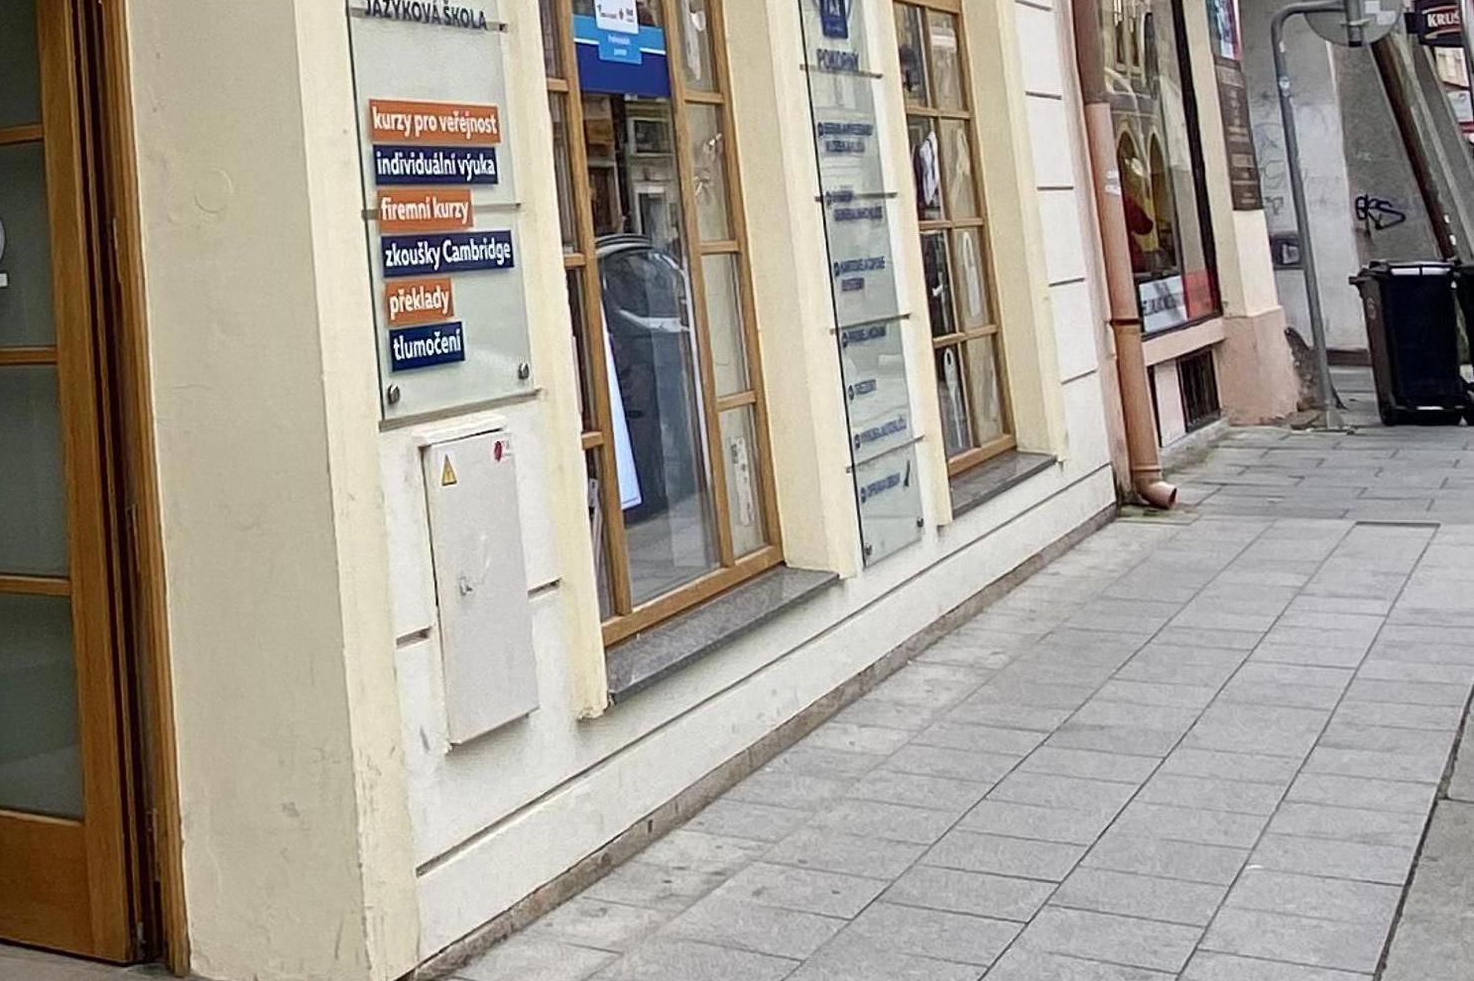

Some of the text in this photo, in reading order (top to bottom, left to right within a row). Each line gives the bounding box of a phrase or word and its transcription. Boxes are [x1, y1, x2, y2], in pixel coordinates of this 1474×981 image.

[443, 0, 488, 31] ŠKOLA
[372, 106, 498, 140] kurzy pro veřejnost
[377, 151, 496, 181] individuální výuka
[380, 196, 470, 225] firemní kurzy
[384, 239, 512, 271] zkoušky Cambridge
[389, 284, 451, 320] překlady
[392, 332, 462, 361] tlumočení
